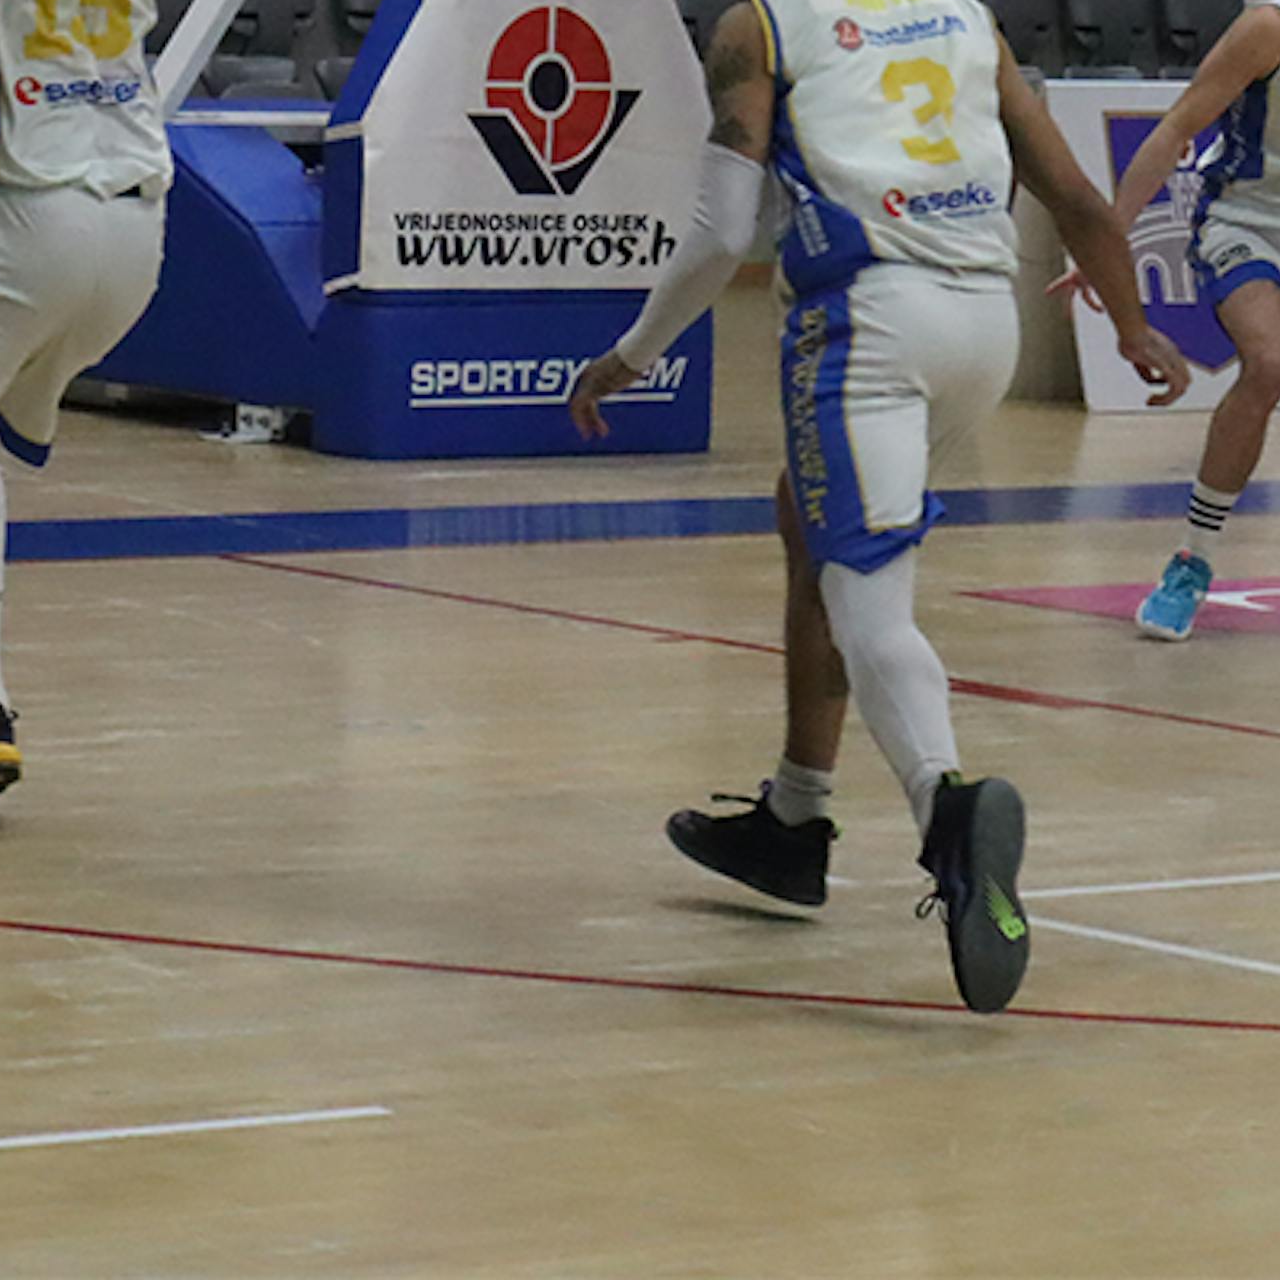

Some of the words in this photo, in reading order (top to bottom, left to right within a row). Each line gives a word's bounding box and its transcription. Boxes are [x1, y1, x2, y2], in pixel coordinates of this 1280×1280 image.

[880, 57, 962, 165] 3
[394, 214, 567, 231] VRIJEDNOSNICE
[573, 213, 650, 231] OSIJEK
[410, 357, 688, 397] SPORTSYM
